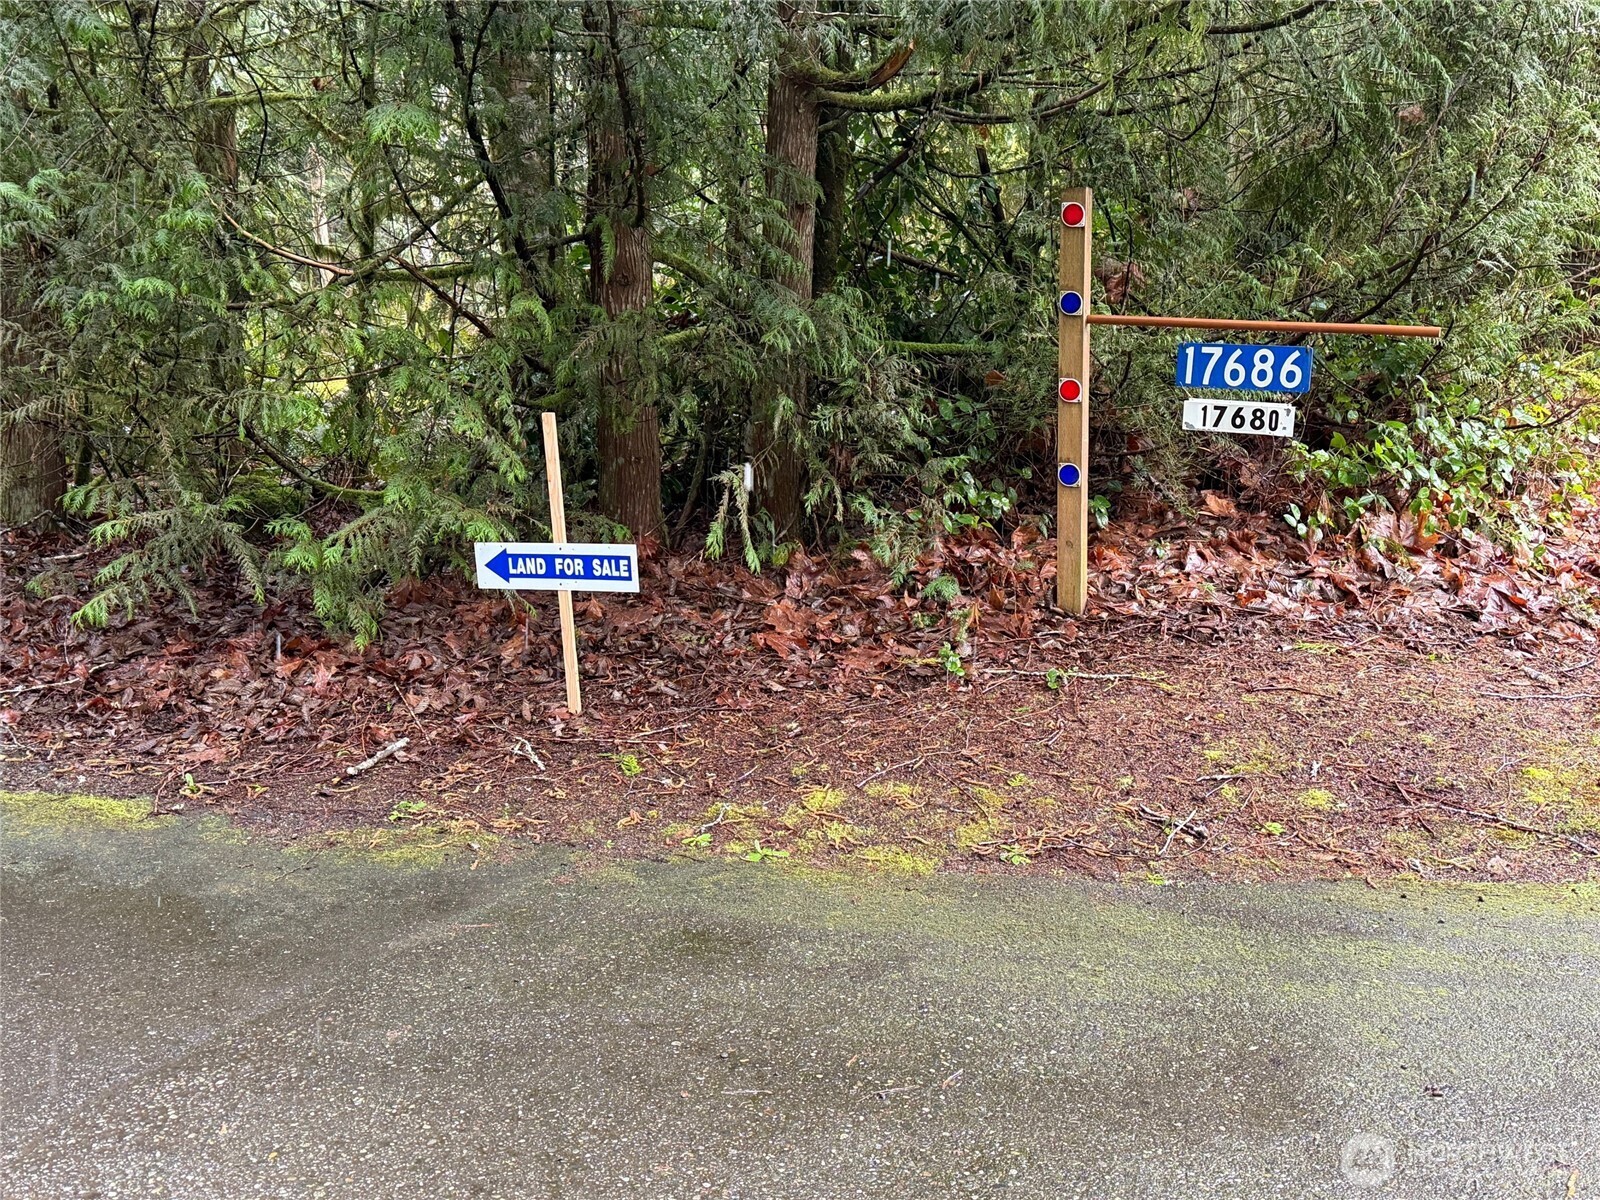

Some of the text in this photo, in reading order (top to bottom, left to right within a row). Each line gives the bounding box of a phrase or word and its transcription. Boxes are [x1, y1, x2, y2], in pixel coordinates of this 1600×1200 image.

[1186, 346, 1303, 389] 17686
[1201, 405, 1279, 432] 17680
[507, 557, 630, 577] LAND FOR SALE
